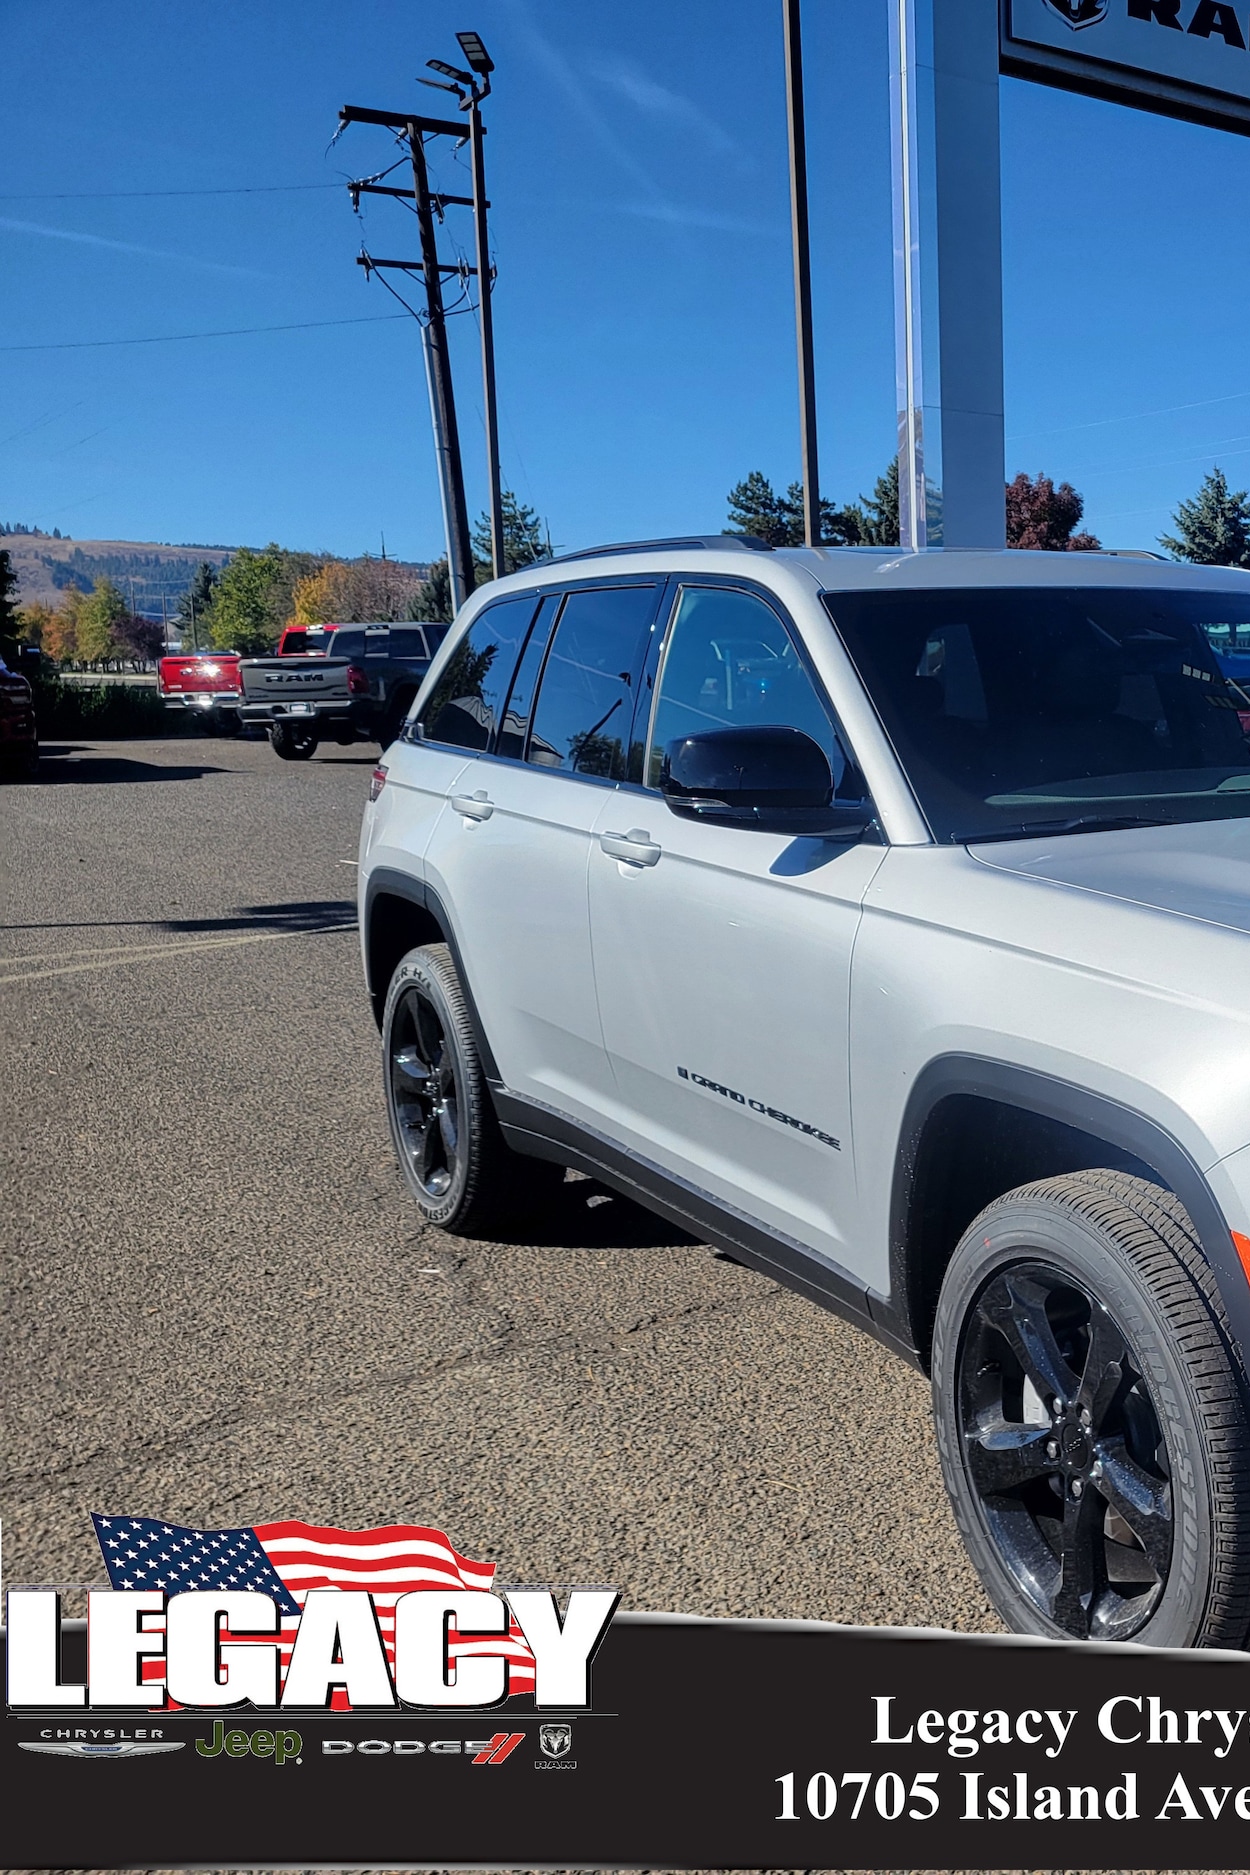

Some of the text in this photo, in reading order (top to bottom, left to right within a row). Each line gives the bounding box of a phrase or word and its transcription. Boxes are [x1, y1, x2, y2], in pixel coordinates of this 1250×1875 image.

[265, 673, 324, 683] RAM
[690, 1073, 746, 1105] GRAND
[748, 1098, 842, 1152] CHEROKEE
